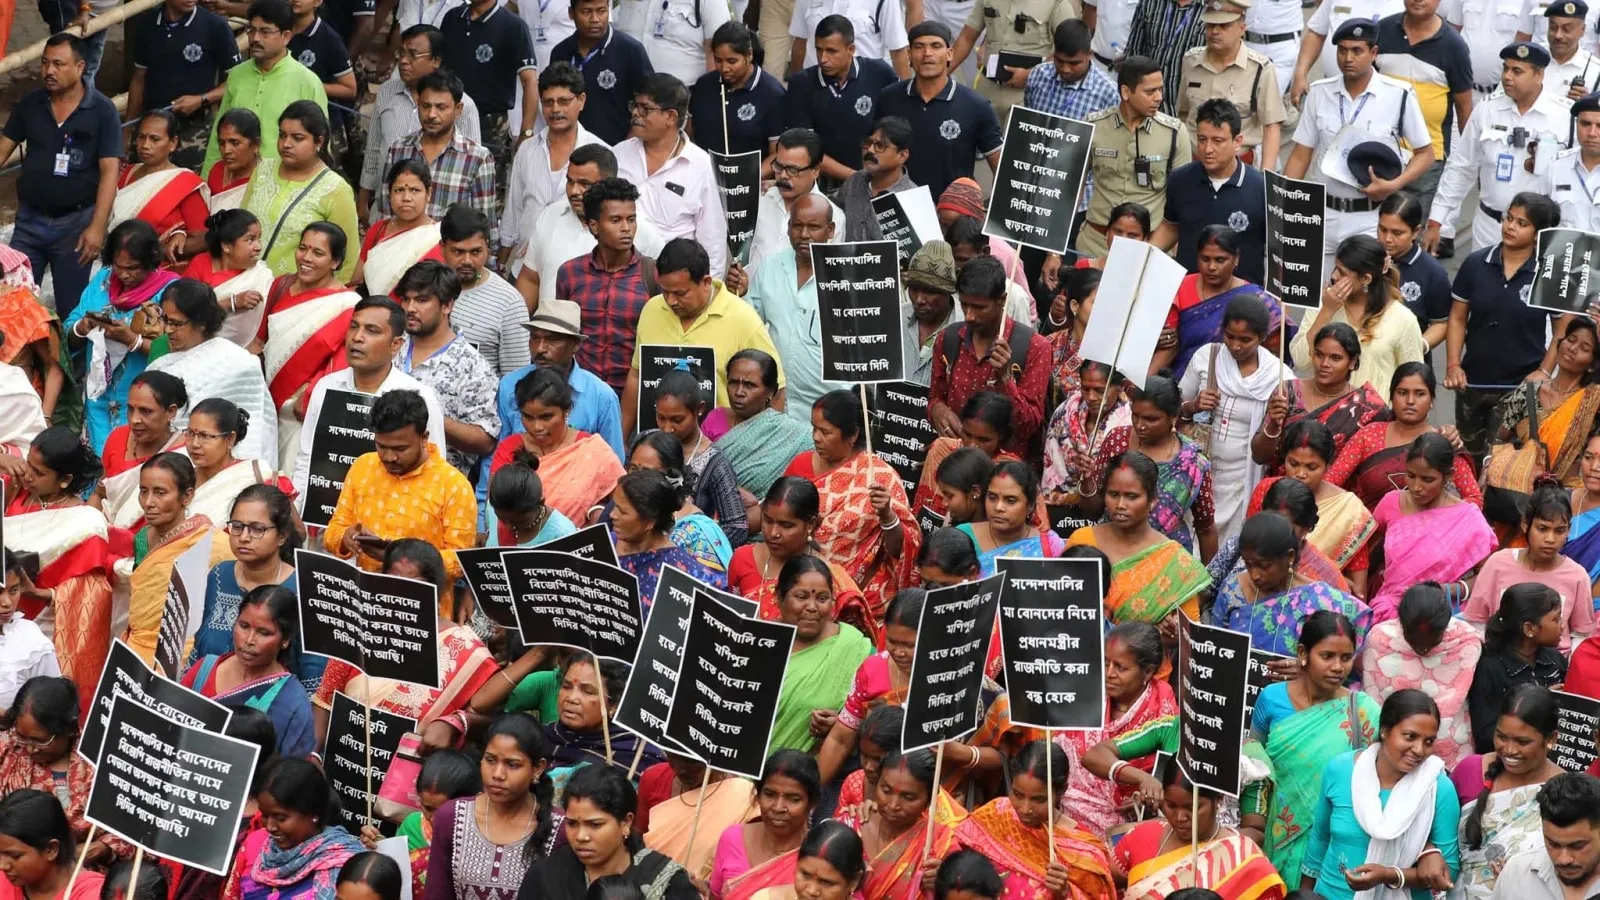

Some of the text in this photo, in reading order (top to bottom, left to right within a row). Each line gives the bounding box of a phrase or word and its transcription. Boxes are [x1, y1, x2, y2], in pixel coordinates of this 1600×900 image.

[1019, 122, 1080, 143] সন্দেশখালি কে
[1030, 143, 1059, 157] মণিপুর
[1013, 160, 1067, 180] হতে দেবো না
[1010, 179, 1061, 199] আমরা সবাই
[1010, 198, 1052, 217] দিদির হাত
[1005, 219, 1049, 237] ছাড়বো না।
[1284, 213, 1321, 225] আদিবাসী
[825, 252, 881, 266] সন্দেশখালির
[1284, 262, 1310, 272] আলো
[1559, 242, 1573, 298] তোমার পাশে
[819, 277, 895, 292] তপশিলী আদিবাসী
[1291, 286, 1309, 297] দিদি
[833, 307, 881, 317] মা বোনদের
[832, 334, 887, 345] আশার আলো
[834, 359, 889, 372] আমাদের দিদি
[886, 390, 928, 407] সন্দেশখালি
[346, 403, 371, 414] আমরা
[876, 409, 884, 419] মা
[887, 412, 918, 428] বোনদের
[329, 425, 375, 441] সন্দেশখালির
[328, 453, 337, 462] মা
[310, 474, 330, 488] দিদির
[1056, 516, 1085, 528] এগিয়ে
[522, 567, 629, 597] সন্দেশখালির মা-বোনেদের
[1010, 576, 1084, 591] সন্দেশখালির
[317, 584, 350, 604] বিজেপি
[394, 610, 417, 623] নামে
[361, 590, 420, 609] মা-বোনেদের
[529, 579, 567, 590] বিজেপি
[612, 597, 629, 610] নামে
[933, 592, 992, 615] সন্দেশখালি কে
[308, 598, 340, 613] যেভাবে
[370, 620, 402, 635] করছে
[404, 626, 429, 639] তাতে
[522, 594, 558, 603] যেভাবে
[593, 603, 620, 619] করছে
[620, 613, 638, 626] তাতে
[1003, 604, 1096, 620] মা বোনদের নিয়ে
[532, 606, 564, 615] আমরা
[612, 620, 636, 638] আমরা
[703, 611, 756, 646] সন্দেশখালি
[758, 637, 776, 649] কে
[946, 618, 976, 634] মণিপুর
[316, 613, 345, 629] আমরা
[390, 637, 422, 652] আমরা
[553, 618, 578, 630] দিদির
[599, 630, 625, 645] আছি।
[333, 630, 354, 646] দিদির
[373, 650, 404, 664] আছি।
[658, 633, 676, 651] হতে
[928, 638, 981, 661] হতে দেবো না
[1019, 633, 1080, 651] প্রধানমন্ত্রীর
[714, 642, 750, 667] মণিপুর
[1219, 648, 1235, 660] কে
[698, 655, 761, 692] হতে দেবো না
[926, 662, 975, 684] আমরা সবাই
[1013, 658, 1089, 675] রাজনীতি করা
[648, 683, 671, 706] দিদির
[696, 680, 754, 714] আমরা সবাই
[928, 688, 967, 709] দিদির হাত
[1026, 690, 1076, 704] বন্ধ হোক
[1190, 688, 1227, 706] দেবো না
[349, 710, 365, 728] দিদি
[696, 704, 741, 735] দিদির হাত
[922, 718, 954, 734] ছাড়বো
[1197, 713, 1223, 730] সবাই
[1558, 718, 1592, 735] বিজেপি
[120, 721, 163, 751] সন্দেশখালির
[163, 743, 232, 774] মা-বোনেদের
[339, 734, 365, 753] এগিয়ে
[720, 746, 738, 759] না।
[1197, 737, 1217, 752] হাত
[118, 739, 222, 790] বিজেপি রাজনীতির নামে
[1202, 762, 1218, 775] না।
[1557, 755, 1582, 771] দিদির
[107, 754, 133, 774] যেভাবে
[163, 781, 197, 803] করছে
[199, 793, 231, 810] তাতে
[108, 772, 131, 793] আমরা
[177, 805, 216, 825] আমরা
[116, 795, 190, 838] দিদির পাশে আছি।
